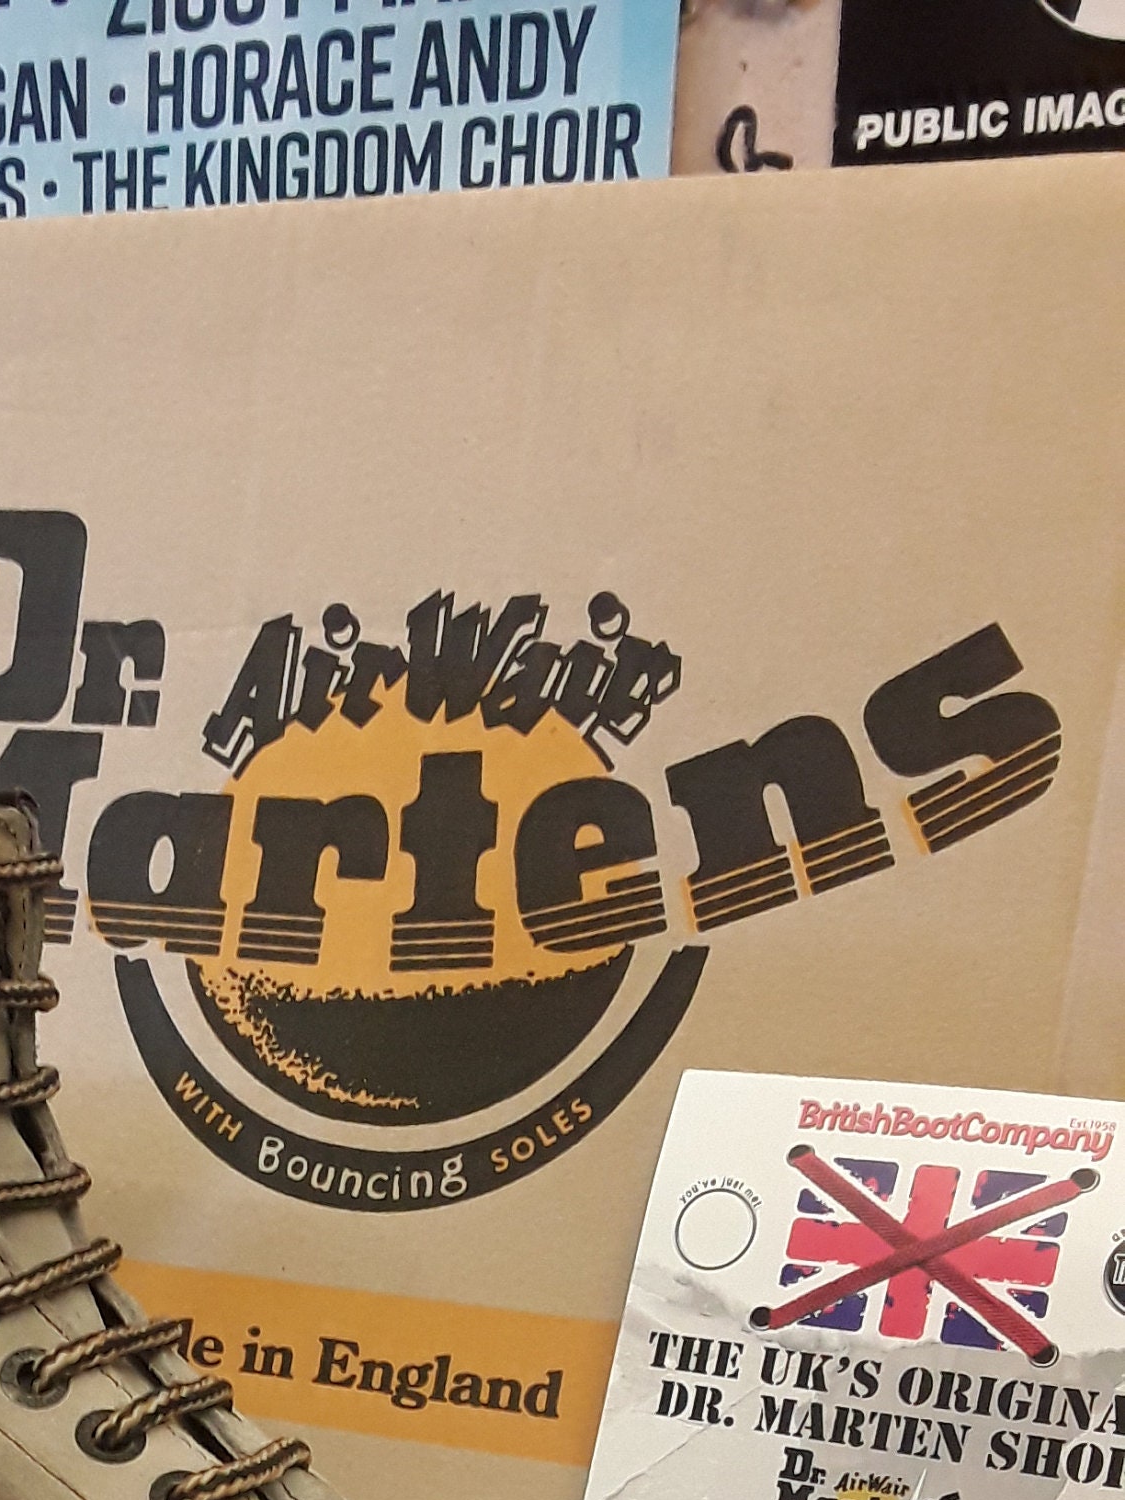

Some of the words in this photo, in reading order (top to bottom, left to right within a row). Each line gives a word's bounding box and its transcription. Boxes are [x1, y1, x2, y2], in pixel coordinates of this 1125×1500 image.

[147, 25, 392, 134] HORACE
[408, 5, 597, 110] ANDY
[73, 145, 171, 215] THE
[184, 121, 443, 209] KINGDOM
[459, 103, 642, 190] CHOIR
[855, 100, 1009, 151] PUBLIC
[173, 1071, 244, 1142] WITH
[257, 1134, 468, 1201] Bouncing
[490, 1097, 594, 1173] SOLES
[797, 1098, 1115, 1162] BritishBootCompany
[239, 1325, 294, 1380] in
[312, 1335, 565, 1420] England
[649, 1331, 744, 1380] THE
[759, 1347, 883, 1400] UK'S
[897, 1366, 1125, 1436] ORIGINA
[655, 1380, 735, 1428] DR.
[753, 1394, 972, 1465] MARTEN
[833, 1471, 911, 1498] AirWair
